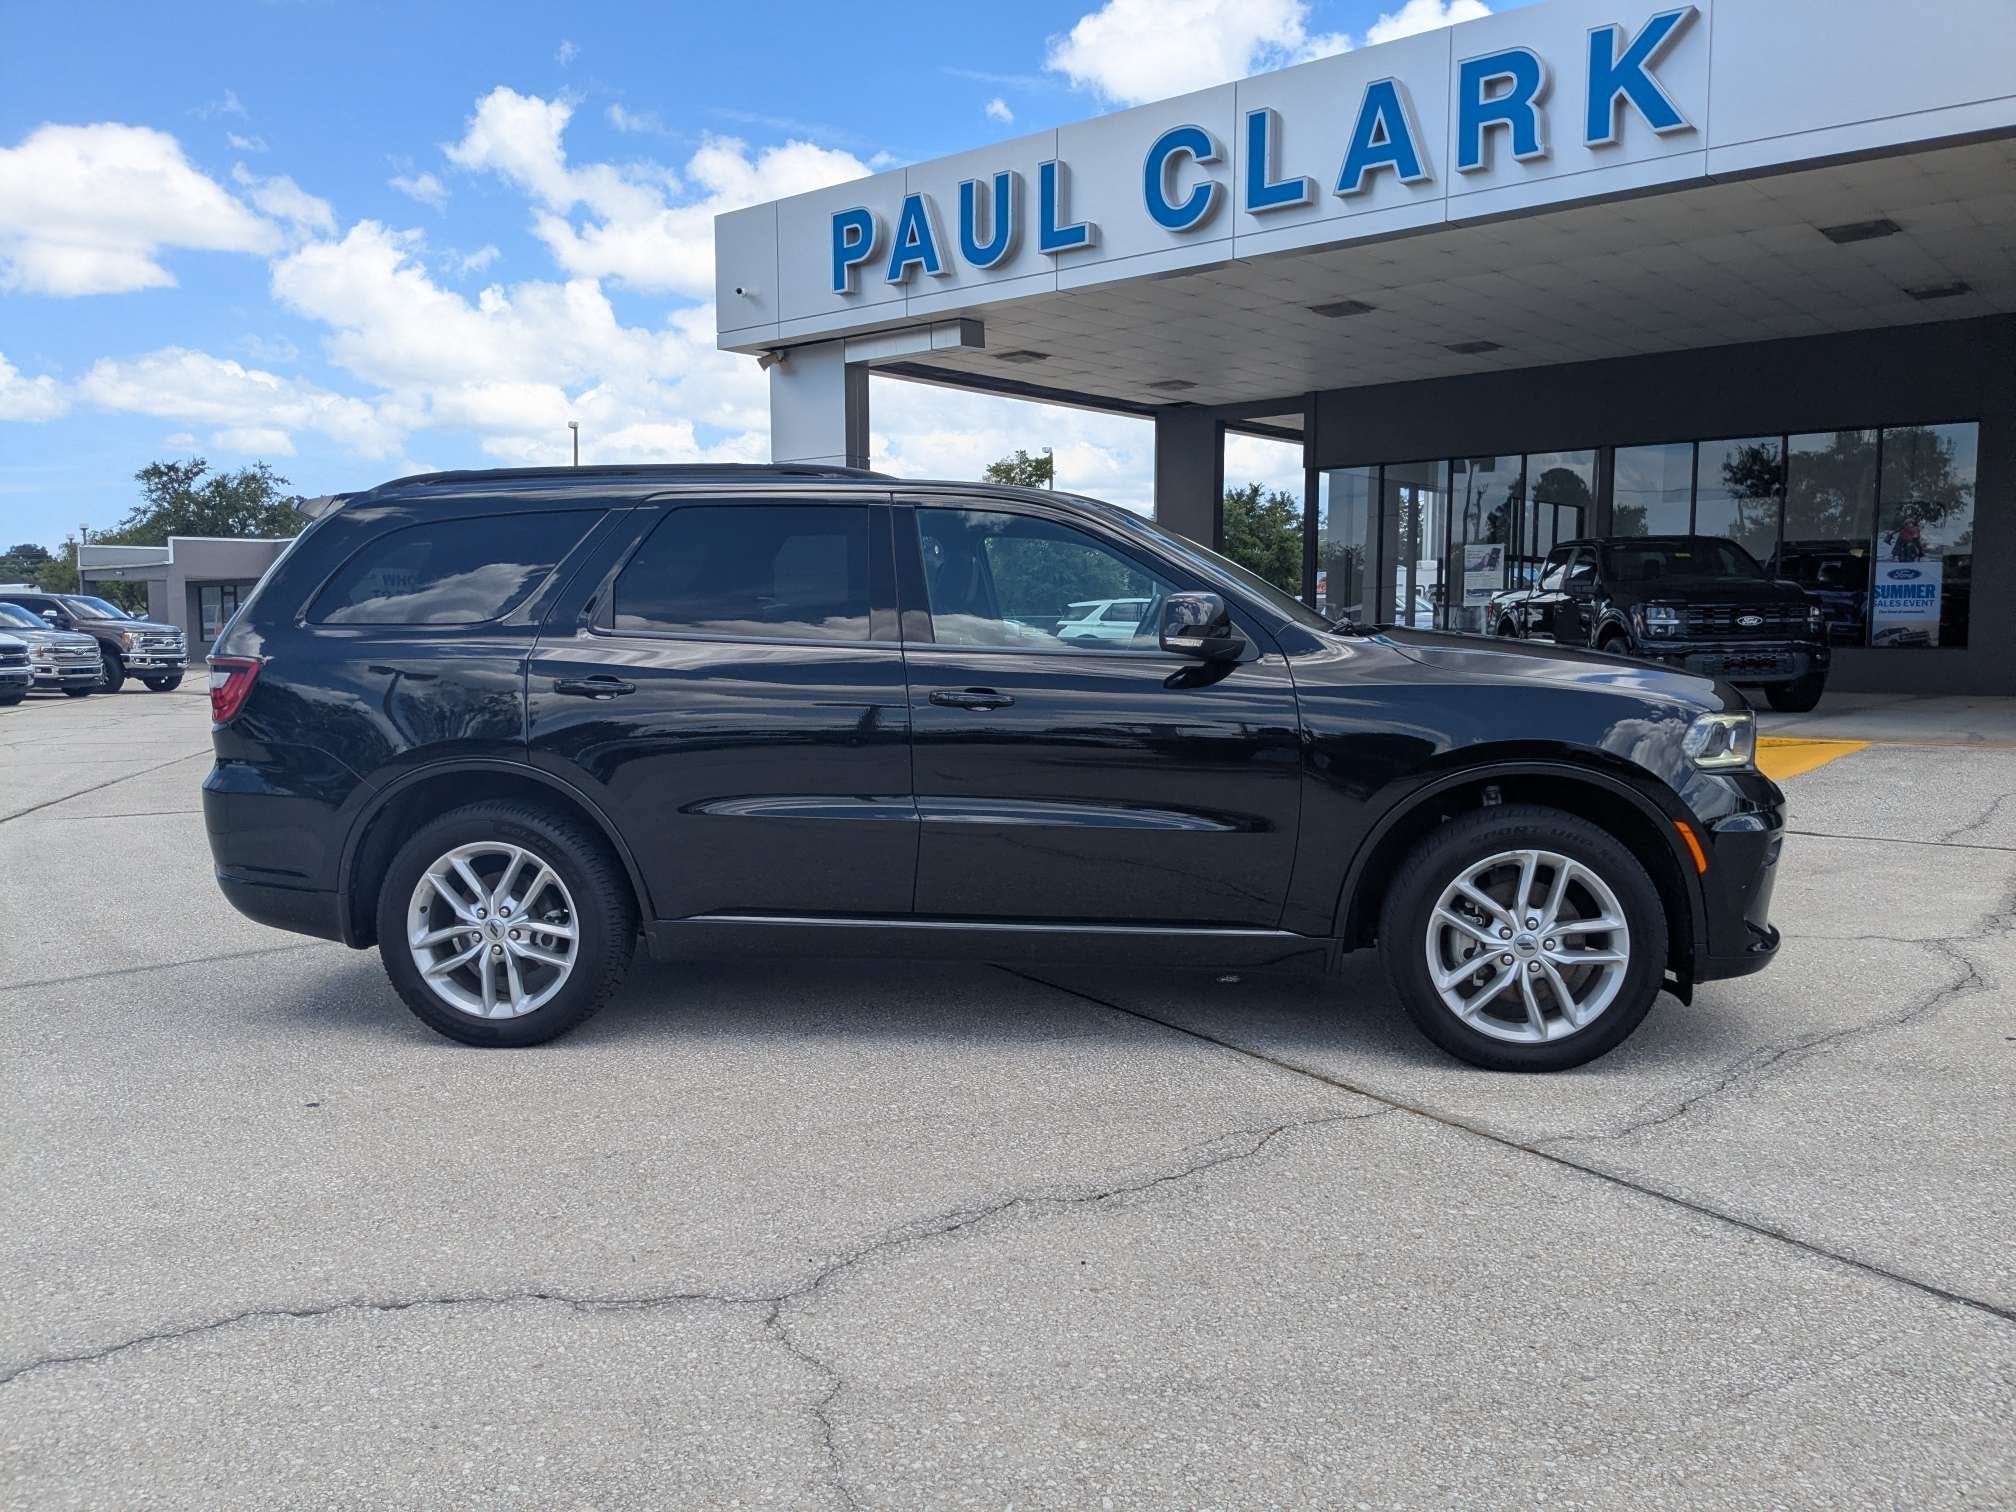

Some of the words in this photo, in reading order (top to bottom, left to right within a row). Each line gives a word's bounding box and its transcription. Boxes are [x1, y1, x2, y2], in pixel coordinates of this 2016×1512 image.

[831, 159, 1097, 295] PAUL
[1142, 4, 1701, 233] CLARK
[1873, 584, 1936, 599] SUMMER
[1873, 600, 1901, 608] SALES
[1903, 600, 1934, 608] EVENT
